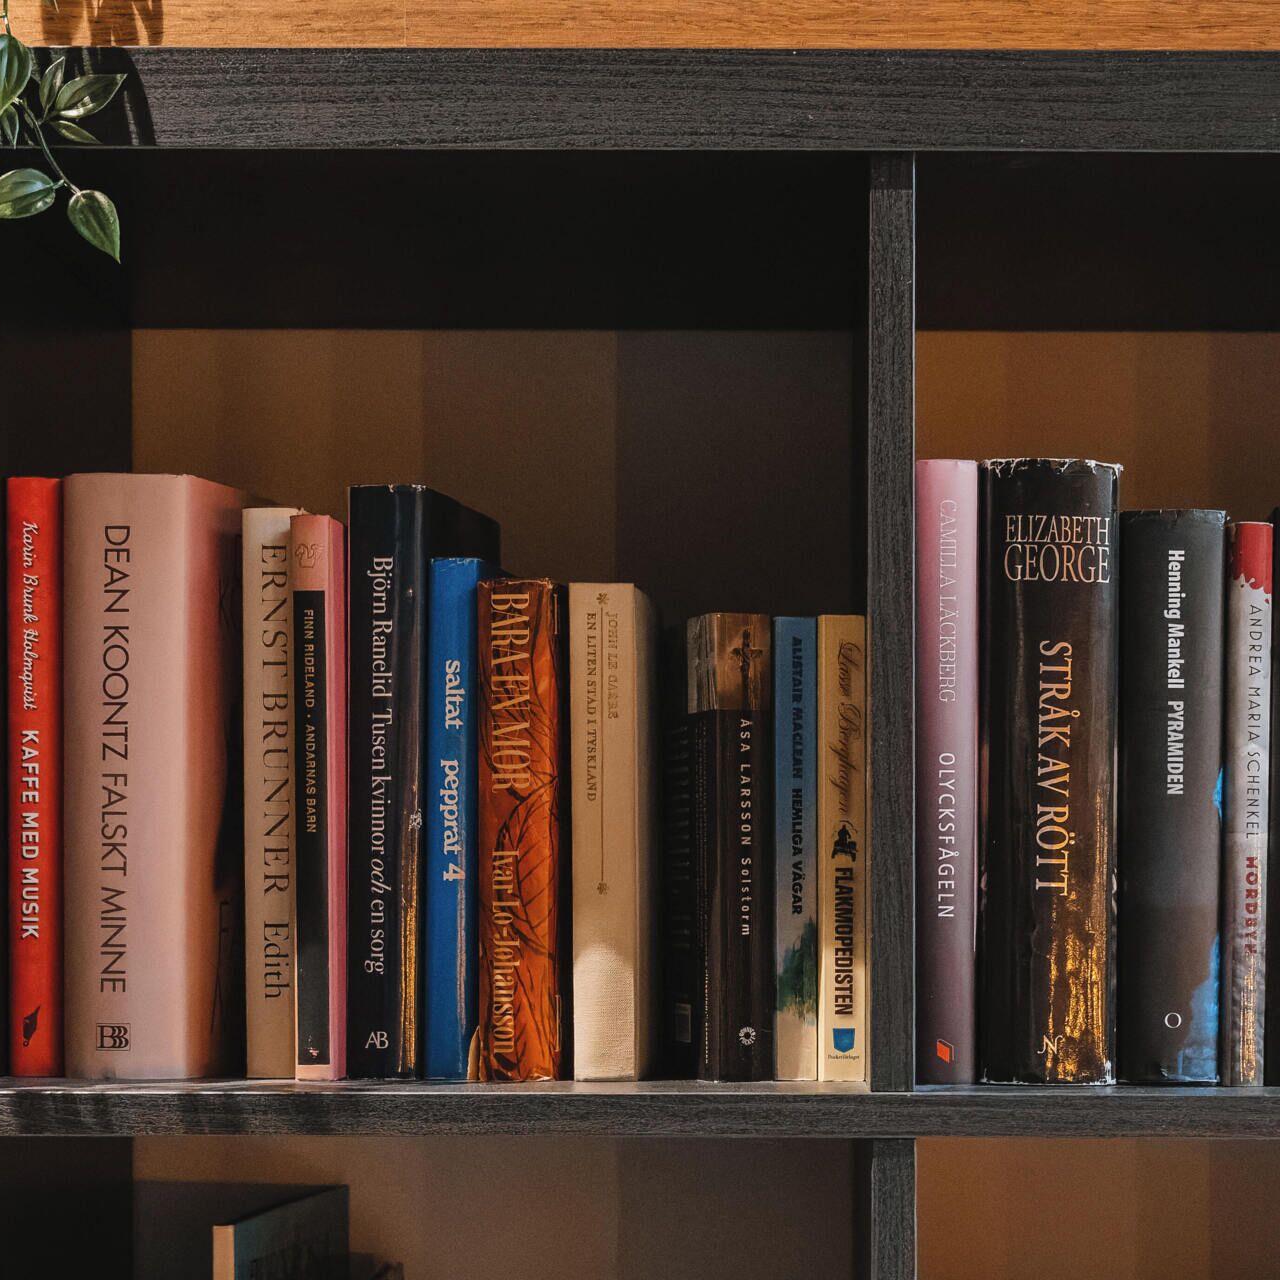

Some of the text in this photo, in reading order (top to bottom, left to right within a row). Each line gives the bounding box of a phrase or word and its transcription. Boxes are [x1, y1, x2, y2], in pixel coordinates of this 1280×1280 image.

[100, 525, 130, 993] DEAN KOONTZ FALSKT MINNE
[260, 543, 291, 999] ERNST BRUNNER Edith
[304, 609, 317, 833] FINN RIDELAND ANDARNAS BARN
[364, 557, 393, 975] Björn Ranelid Tusen kvinnor och en sorg
[440, 659, 465, 882] saltat pepprat 4
[937, 499, 960, 918] CAMILLA LÄCKBERG OLYCKSFÅGELN
[1034, 640, 1081, 897] STRÅK AV RÖTT
[1164, 550, 1185, 795] Henning Mankell PYRAMIDEN
[21, 730, 40, 939] KAFFE MED MUSIK
[739, 719, 753, 936] ÅSA LARSSON Solstorm
[834, 867, 855, 1016] FLAKMOPEDISTEN
